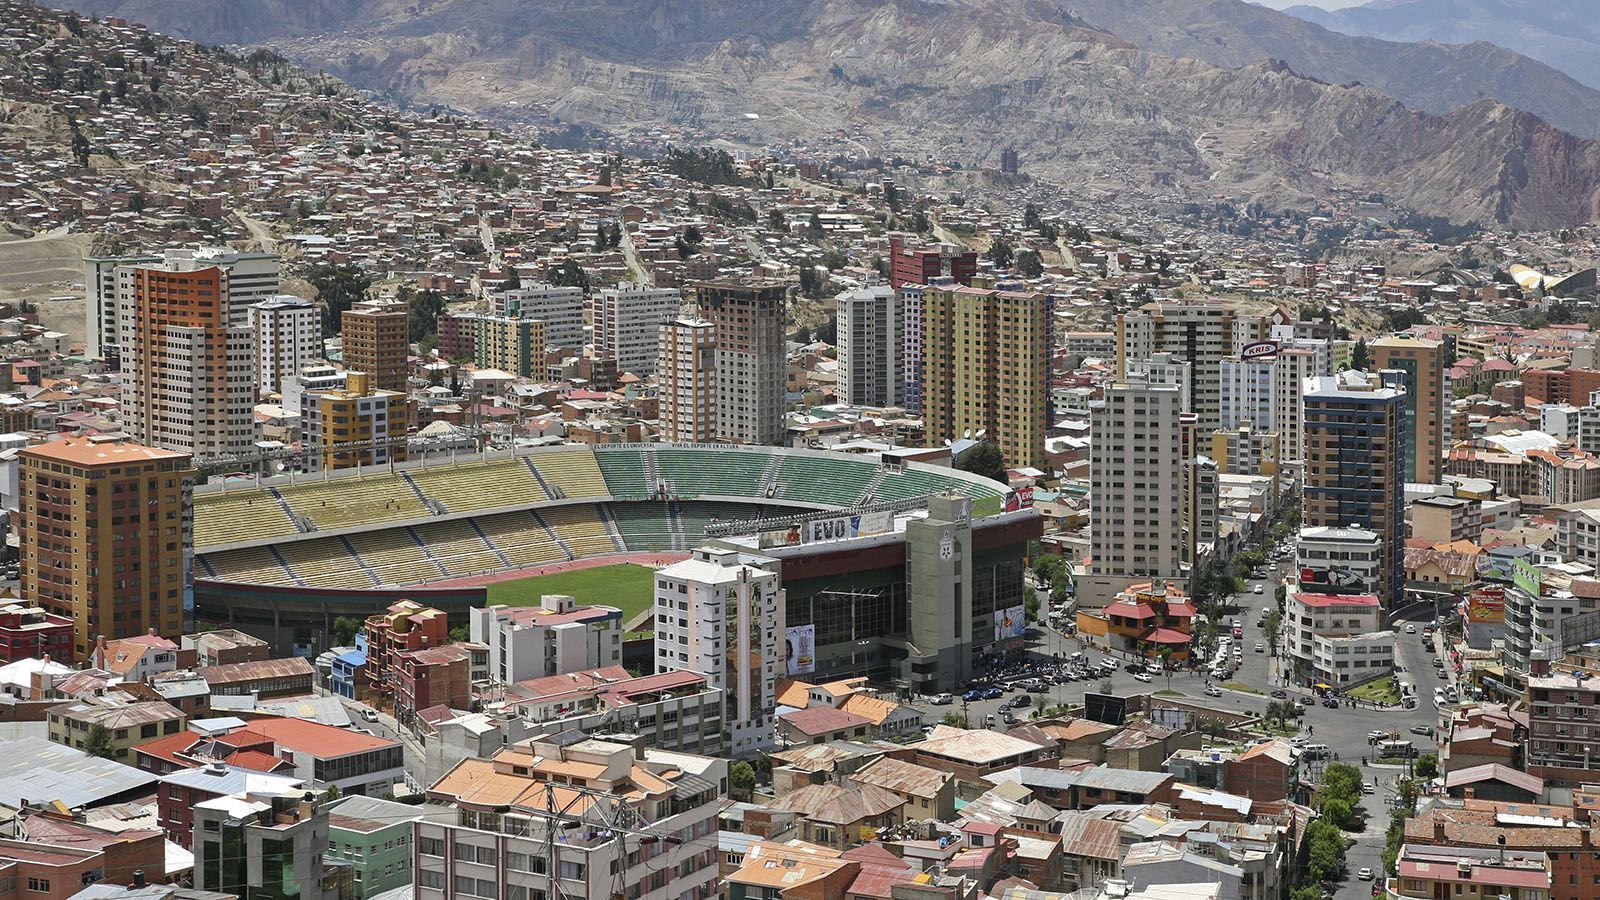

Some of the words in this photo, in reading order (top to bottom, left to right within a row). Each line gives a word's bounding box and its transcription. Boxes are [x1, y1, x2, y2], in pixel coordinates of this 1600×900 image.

[1249, 345, 1271, 355] KRIS
[1021, 491, 1033, 500] EVO
[814, 520, 845, 540] EVO
